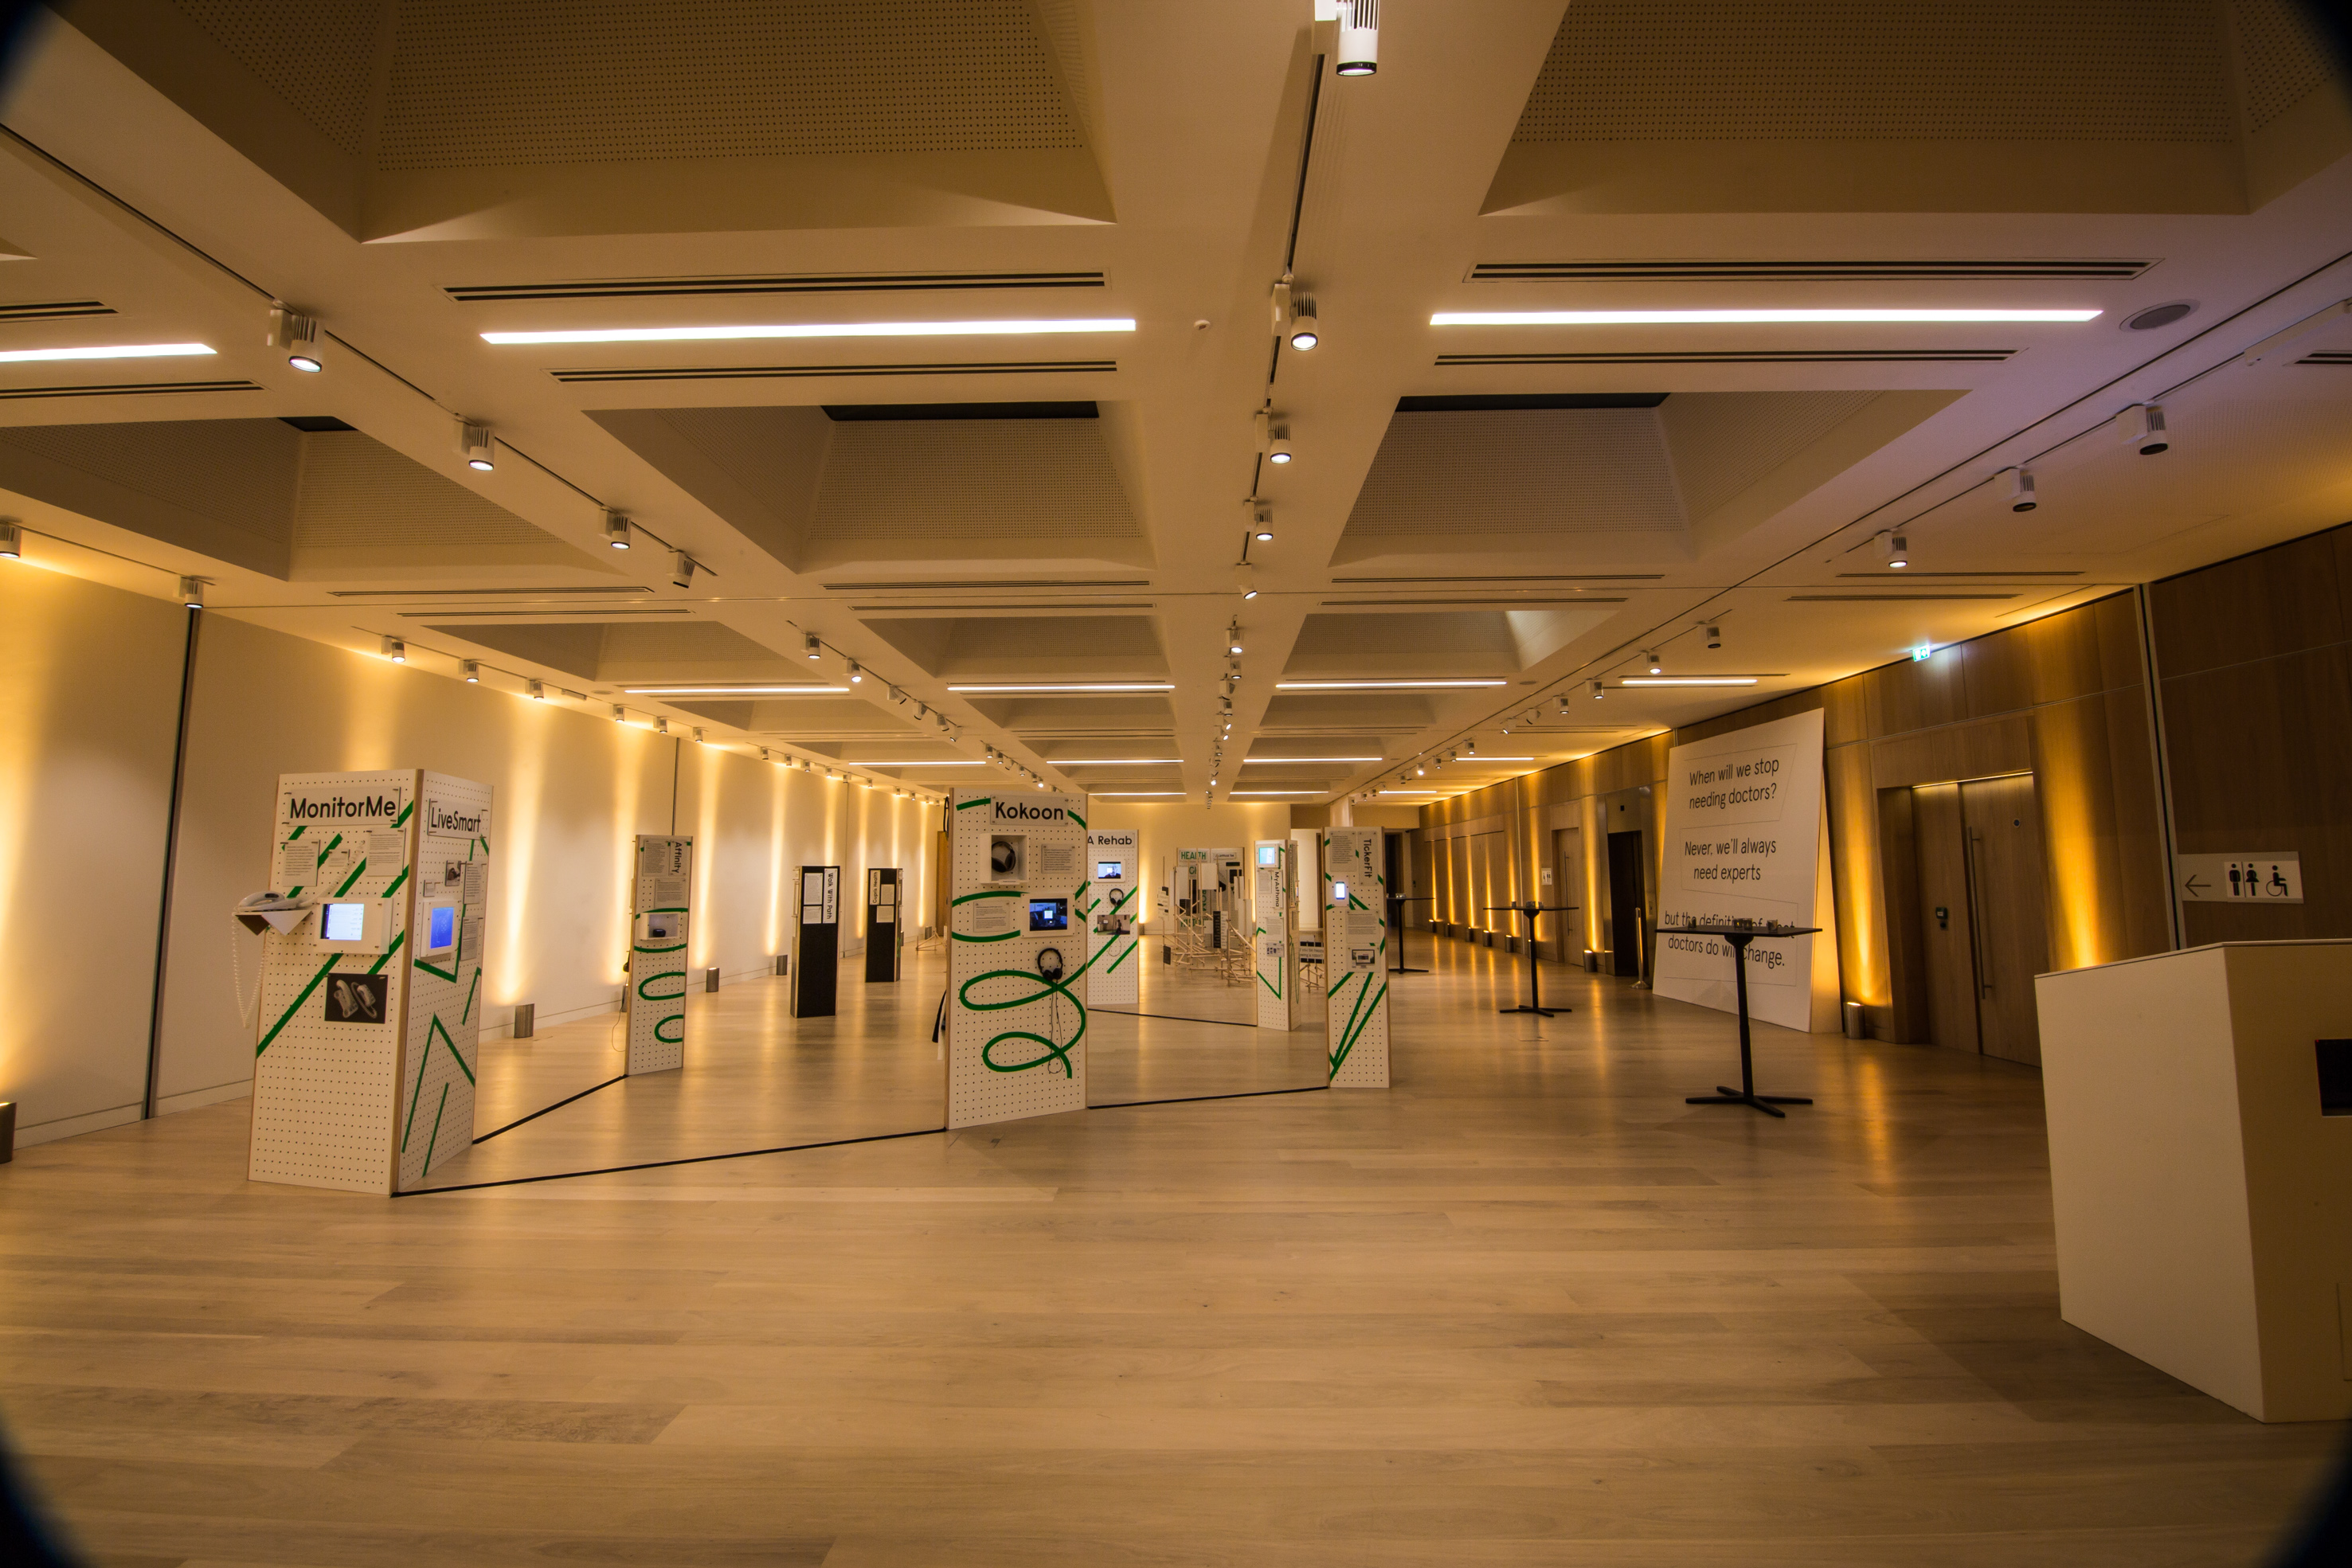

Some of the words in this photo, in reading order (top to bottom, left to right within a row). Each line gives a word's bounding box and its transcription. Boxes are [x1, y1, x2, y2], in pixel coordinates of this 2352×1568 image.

[1689, 770, 1715, 786] When
[1718, 764, 1733, 780] will
[1736, 764, 1751, 778] we
[1754, 758, 1779, 776] stop
[290, 796, 397, 819] MonitorMe
[1689, 792, 1726, 809] needing
[1728, 782, 1777, 804] doctors?
[431, 807, 481, 833] LiveSmart
[996, 801, 1063, 820] Kokoon
[1098, 835, 1132, 845] Rehab
[1716, 838, 1738, 854] we'll
[1741, 837, 1776, 858] always
[671, 842, 682, 874] Affinity
[1364, 839, 1372, 878] TickerFit
[1694, 864, 1718, 879] need
[1720, 864, 1761, 884] experts
[1665, 910, 1679, 925] but
[1700, 913, 1735, 926] definiti
[1669, 935, 1703, 953] doctors
[1706, 939, 1719, 955] do
[1722, 944, 1736, 958] wil
[1743, 944, 1784, 969] change.
